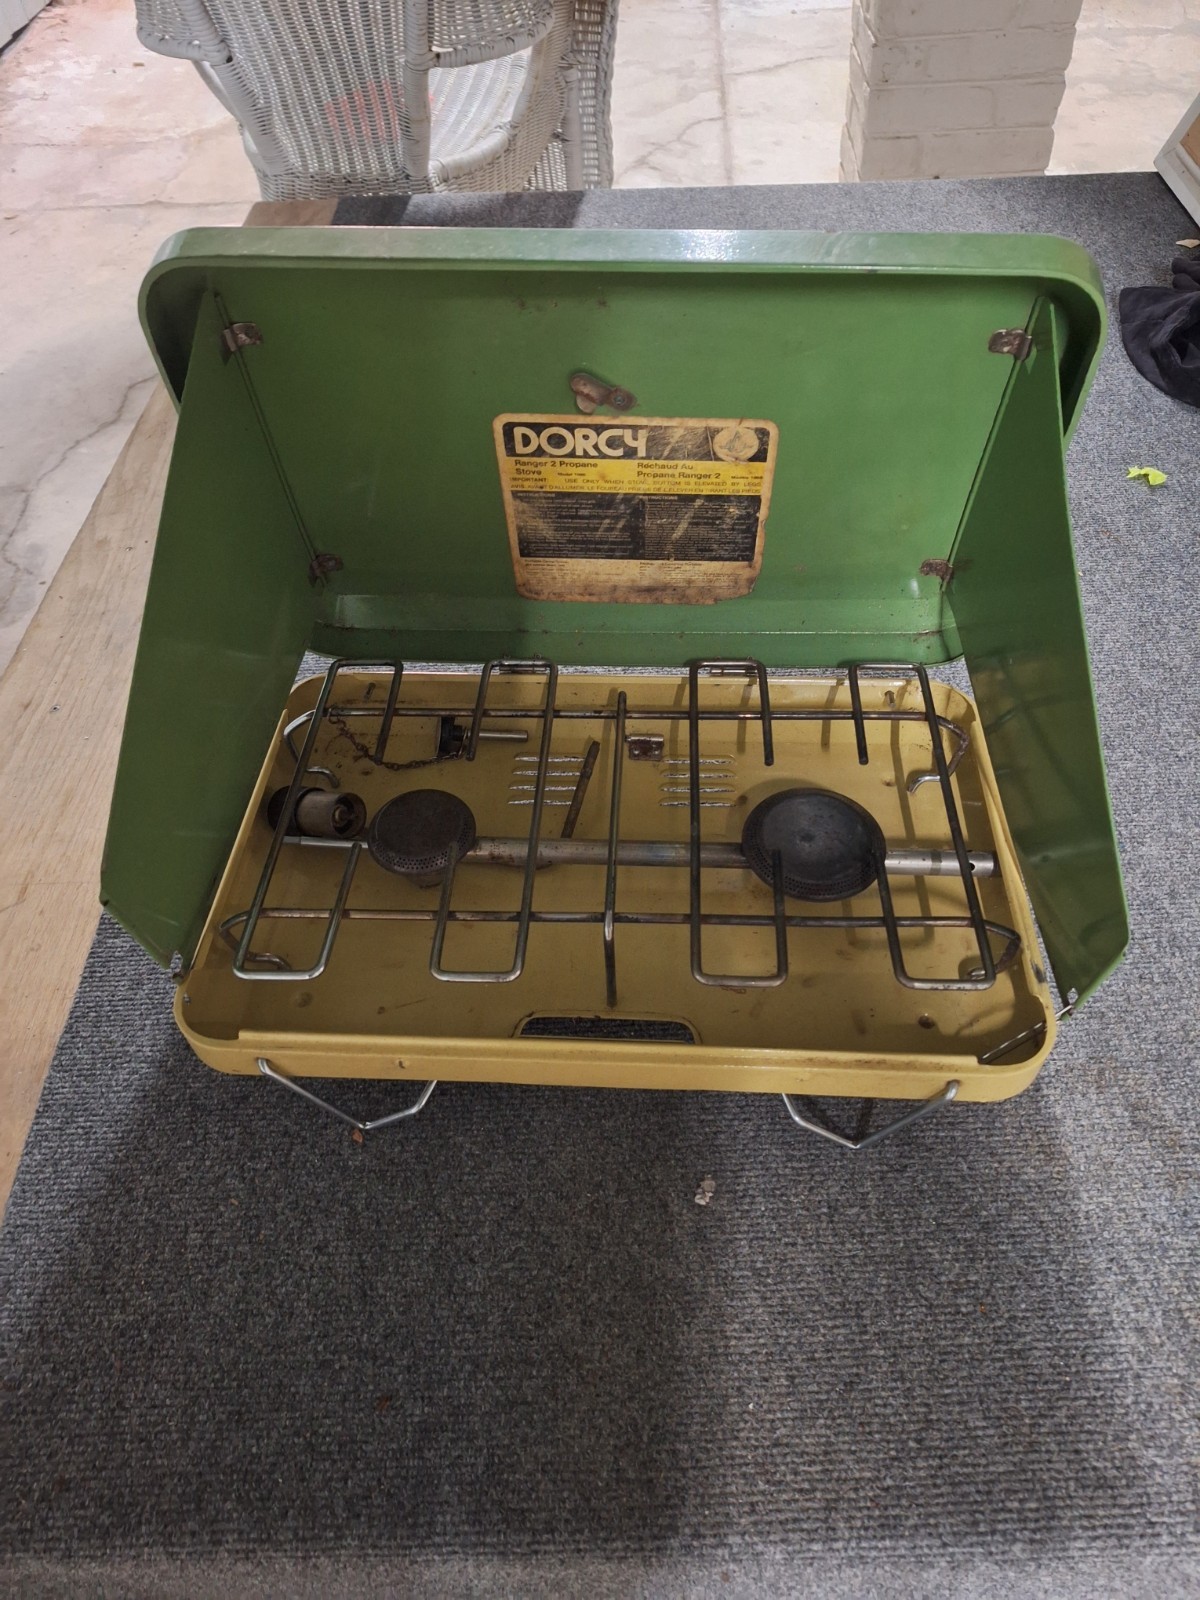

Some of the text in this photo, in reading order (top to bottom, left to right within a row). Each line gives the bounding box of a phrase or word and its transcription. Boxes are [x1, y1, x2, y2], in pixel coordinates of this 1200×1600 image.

[513, 426, 647, 457] DORCY
[514, 460, 548, 468] Ranger
[559, 460, 598, 469] Propane
[515, 468, 542, 476] Stove
[637, 471, 676, 479] Propane
[678, 472, 712, 480] Ranger
